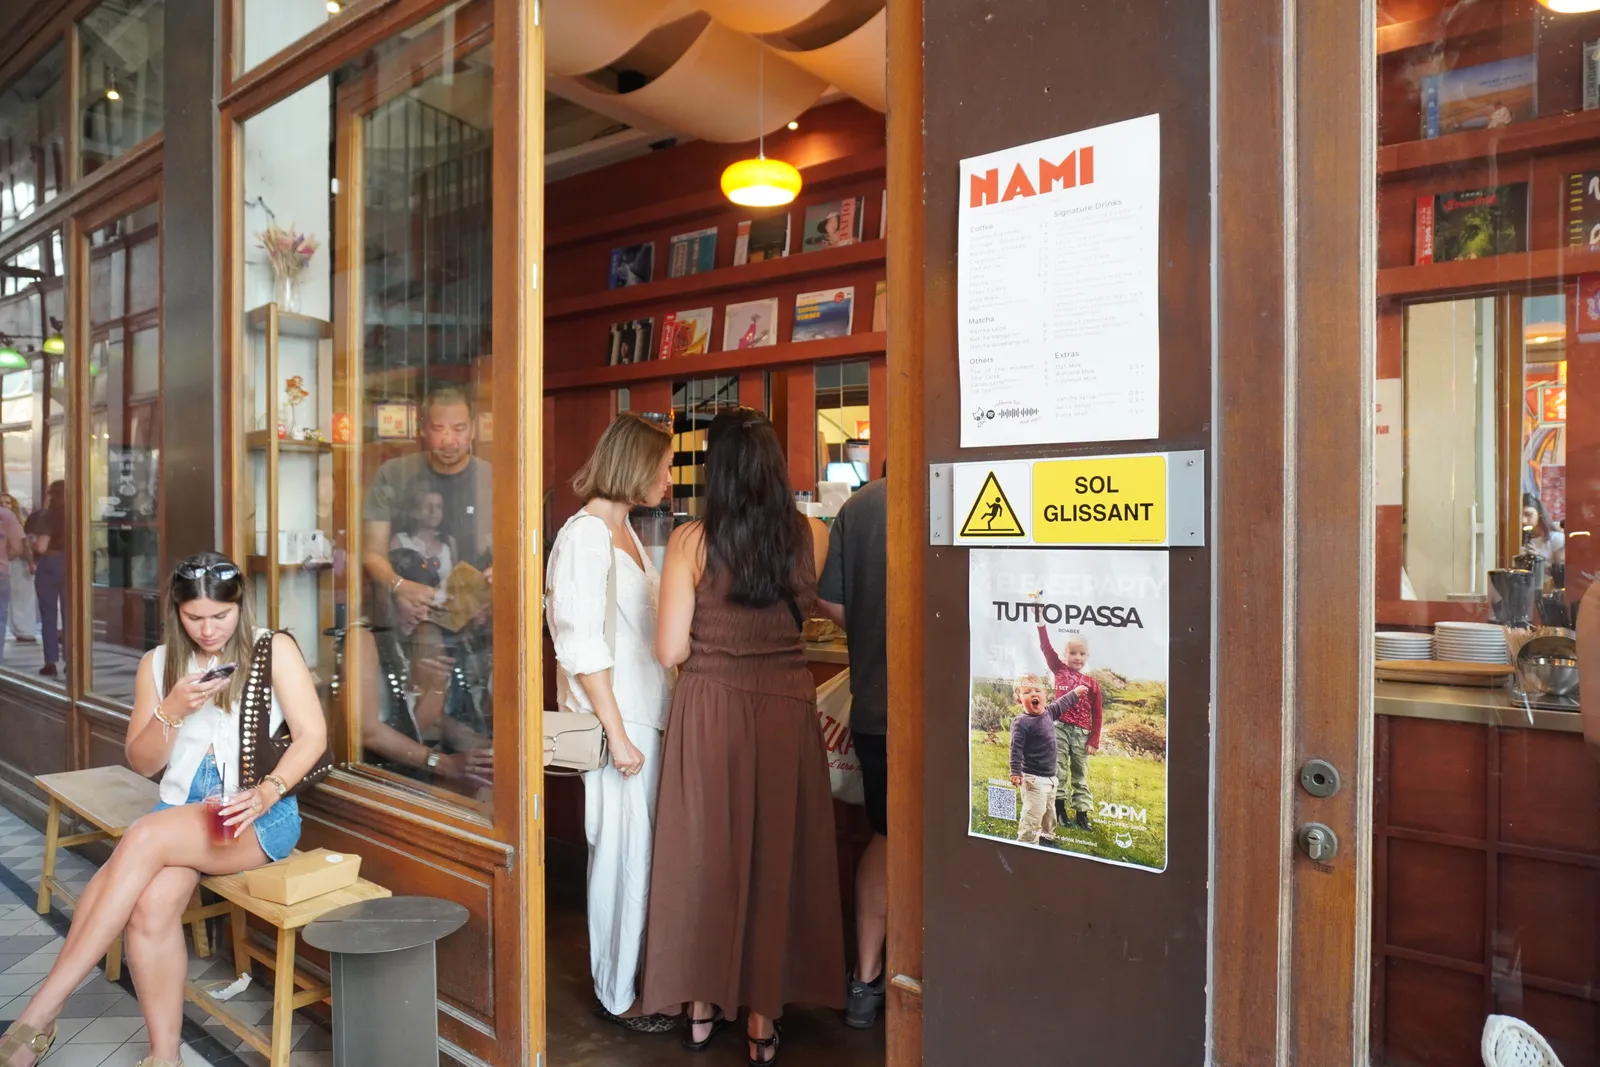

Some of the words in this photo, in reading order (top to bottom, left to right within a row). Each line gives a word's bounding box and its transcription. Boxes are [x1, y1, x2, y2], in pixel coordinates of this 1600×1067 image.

[970, 146, 1094, 208] NAMI
[1054, 205, 1093, 217] Signature
[1096, 199, 1122, 209] Drinks
[970, 224, 994, 233] Coffee
[969, 316, 995, 324] Matcha
[1054, 351, 1079, 359] Extras
[1075, 475, 1119, 494] SOL
[1044, 503, 1153, 522] GLISSANT
[993, 601, 1062, 624] TUTTO
[1065, 605, 1143, 628] PASSA
[1098, 801, 1146, 824] 20PM
[1075, 838, 1097, 847] included
